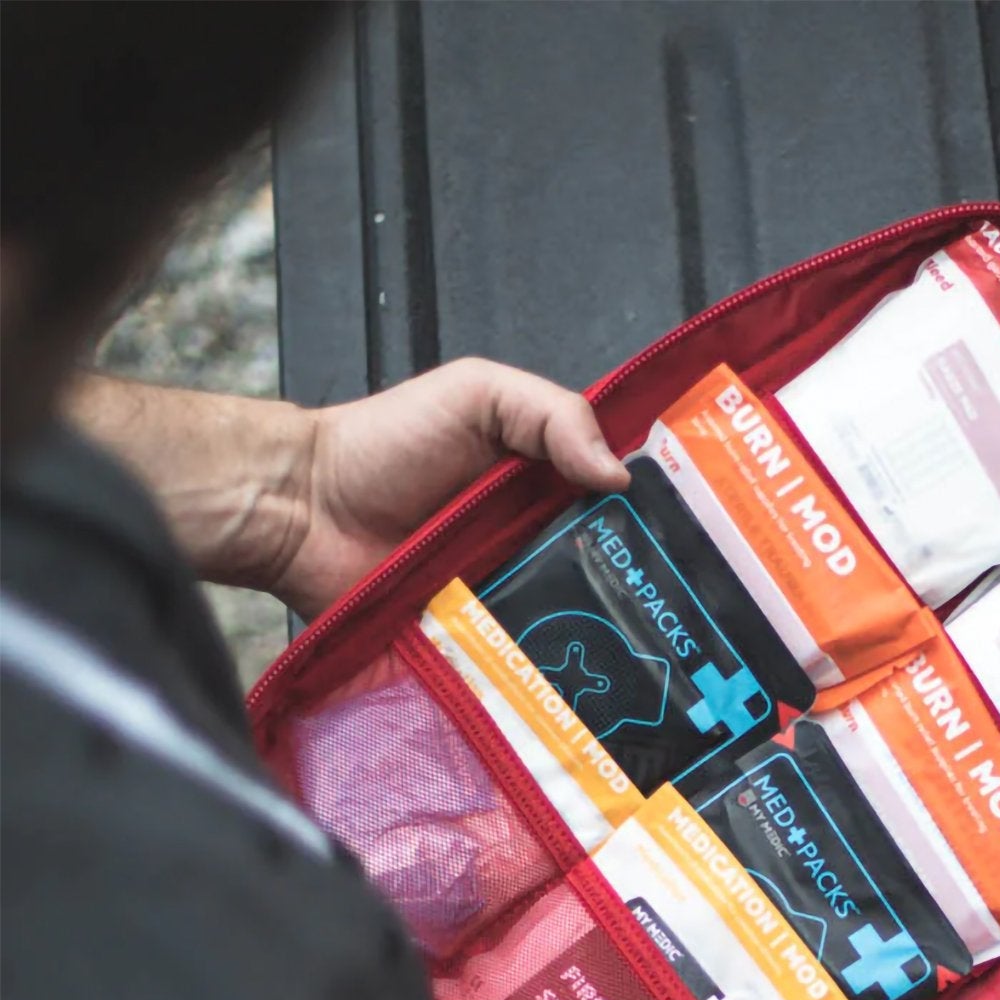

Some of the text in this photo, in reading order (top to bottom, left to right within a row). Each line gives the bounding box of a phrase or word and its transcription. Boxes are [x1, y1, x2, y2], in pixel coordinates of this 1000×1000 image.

[716, 384, 791, 478] BURN
[790, 494, 856, 576] MOD
[461, 599, 577, 731] MEDICATION
[582, 739, 630, 794] MOD
[667, 807, 778, 933] MEDICATION
[781, 943, 829, 999] MOD
[749, 804, 789, 857] MY MEDIC
[632, 906, 653, 925] MY
[646, 923, 681, 961] MEDIC
